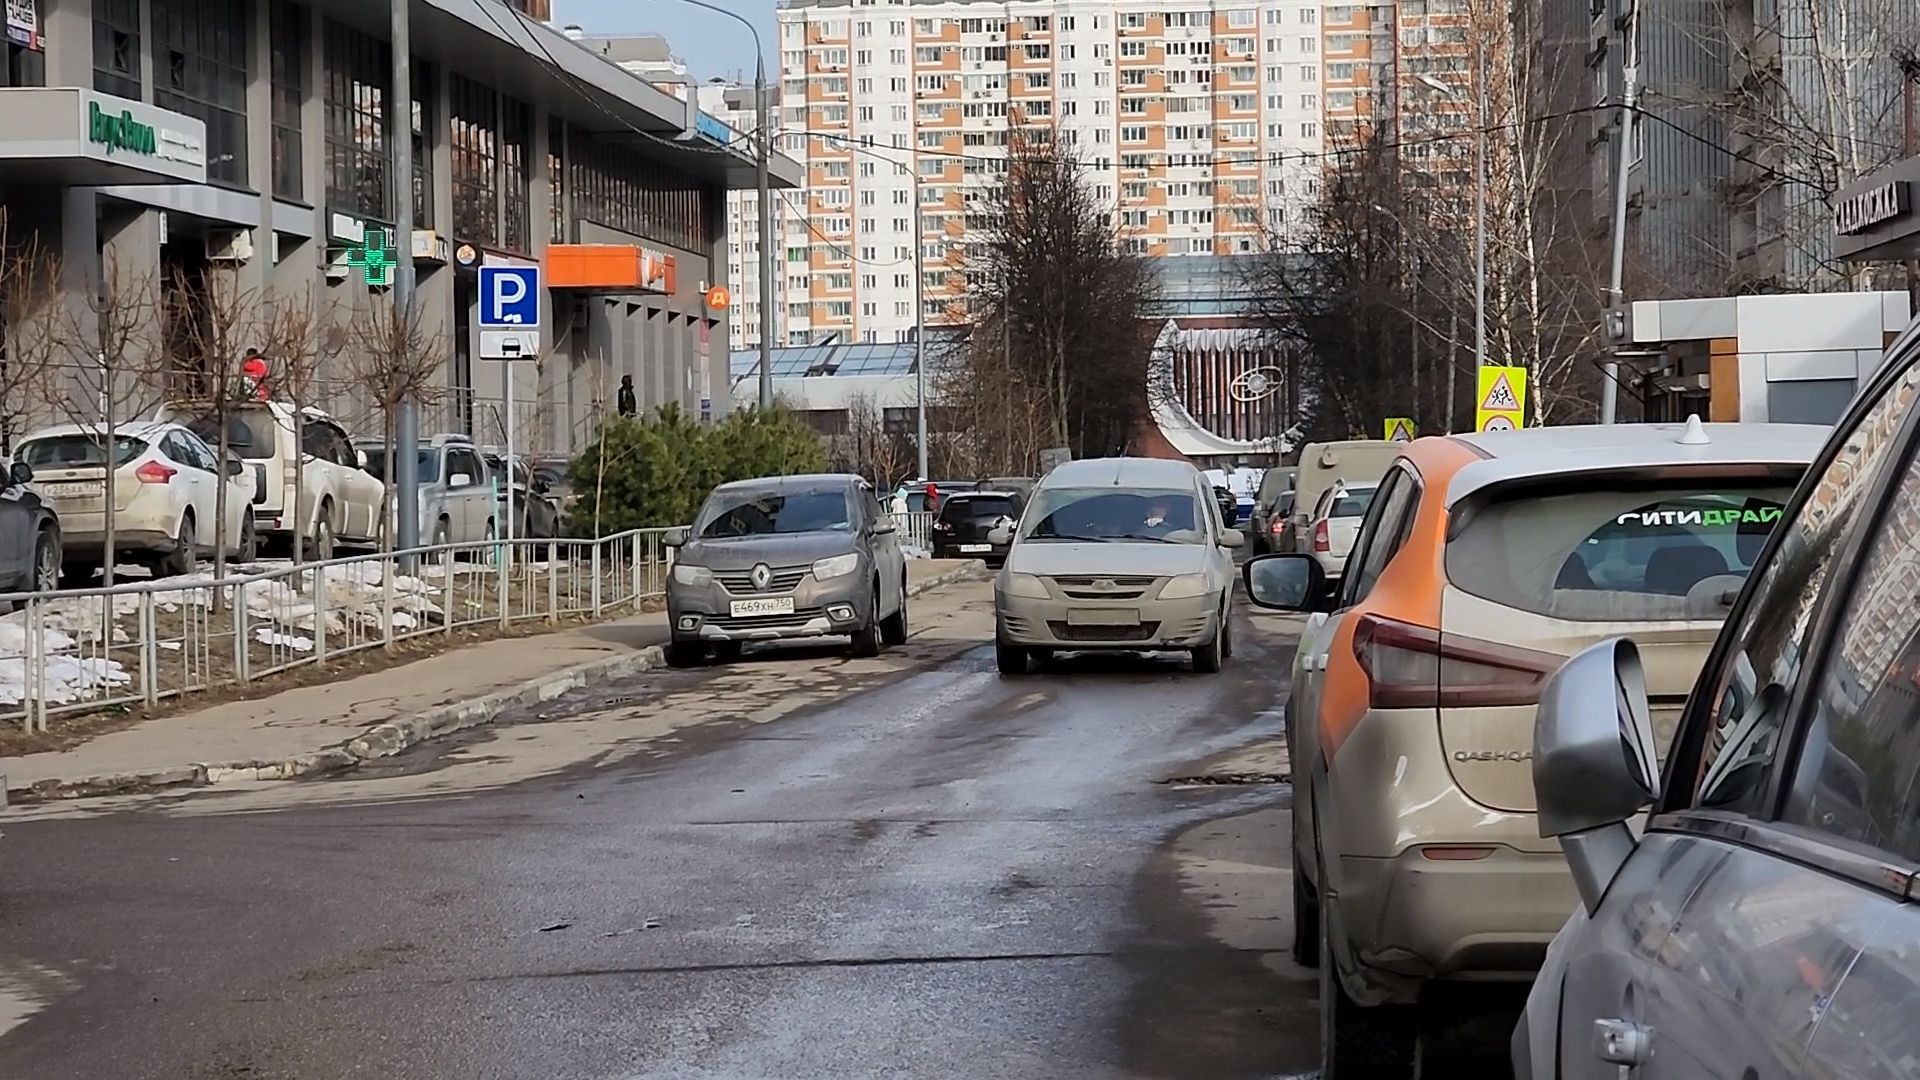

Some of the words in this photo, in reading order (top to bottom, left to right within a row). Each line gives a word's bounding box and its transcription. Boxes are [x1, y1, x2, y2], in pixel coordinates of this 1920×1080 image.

[494, 273, 526, 319] P
[1617, 507, 1783, 526] СИТИДРАЙ
[1455, 751, 1533, 763] QASHQA
